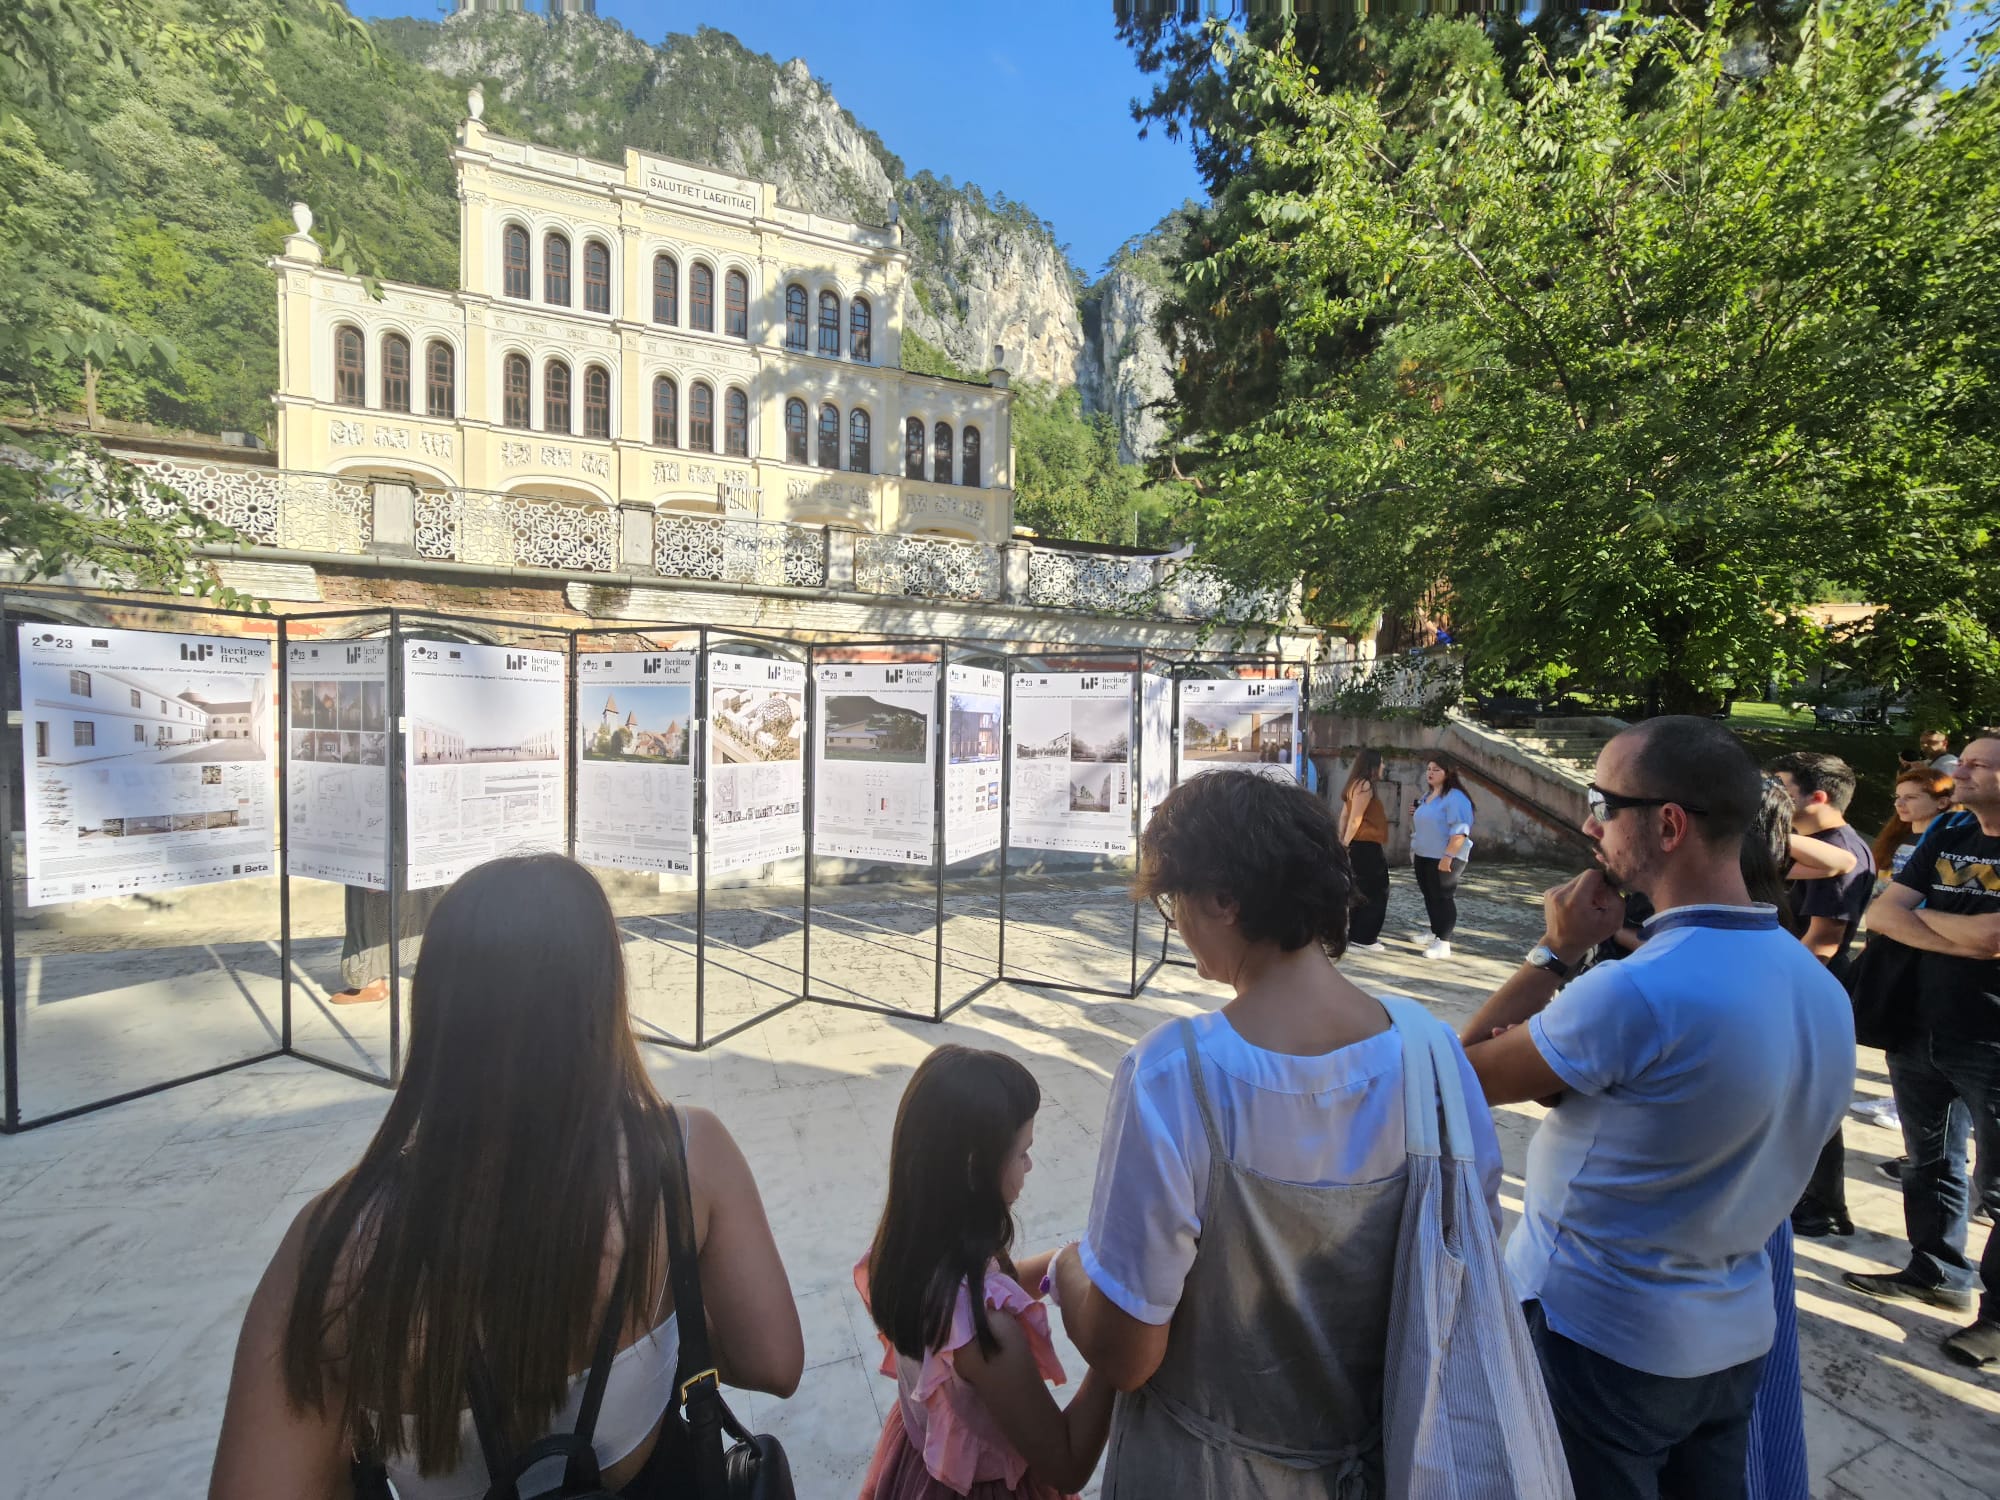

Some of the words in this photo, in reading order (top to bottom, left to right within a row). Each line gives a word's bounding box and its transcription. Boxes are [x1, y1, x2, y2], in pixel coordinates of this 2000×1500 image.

[687, 186, 701, 198] ET
[703, 190, 752, 211] LAETITIAE
[220, 645, 265, 657] heritage
[221, 655, 247, 664] first!
[531, 655, 561, 666] heritage
[664, 658, 691, 667] heritage
[531, 664, 549, 673] first!
[906, 669, 933, 677] heritage
[245, 864, 268, 873] Beta
[674, 862, 688, 871] Beta
